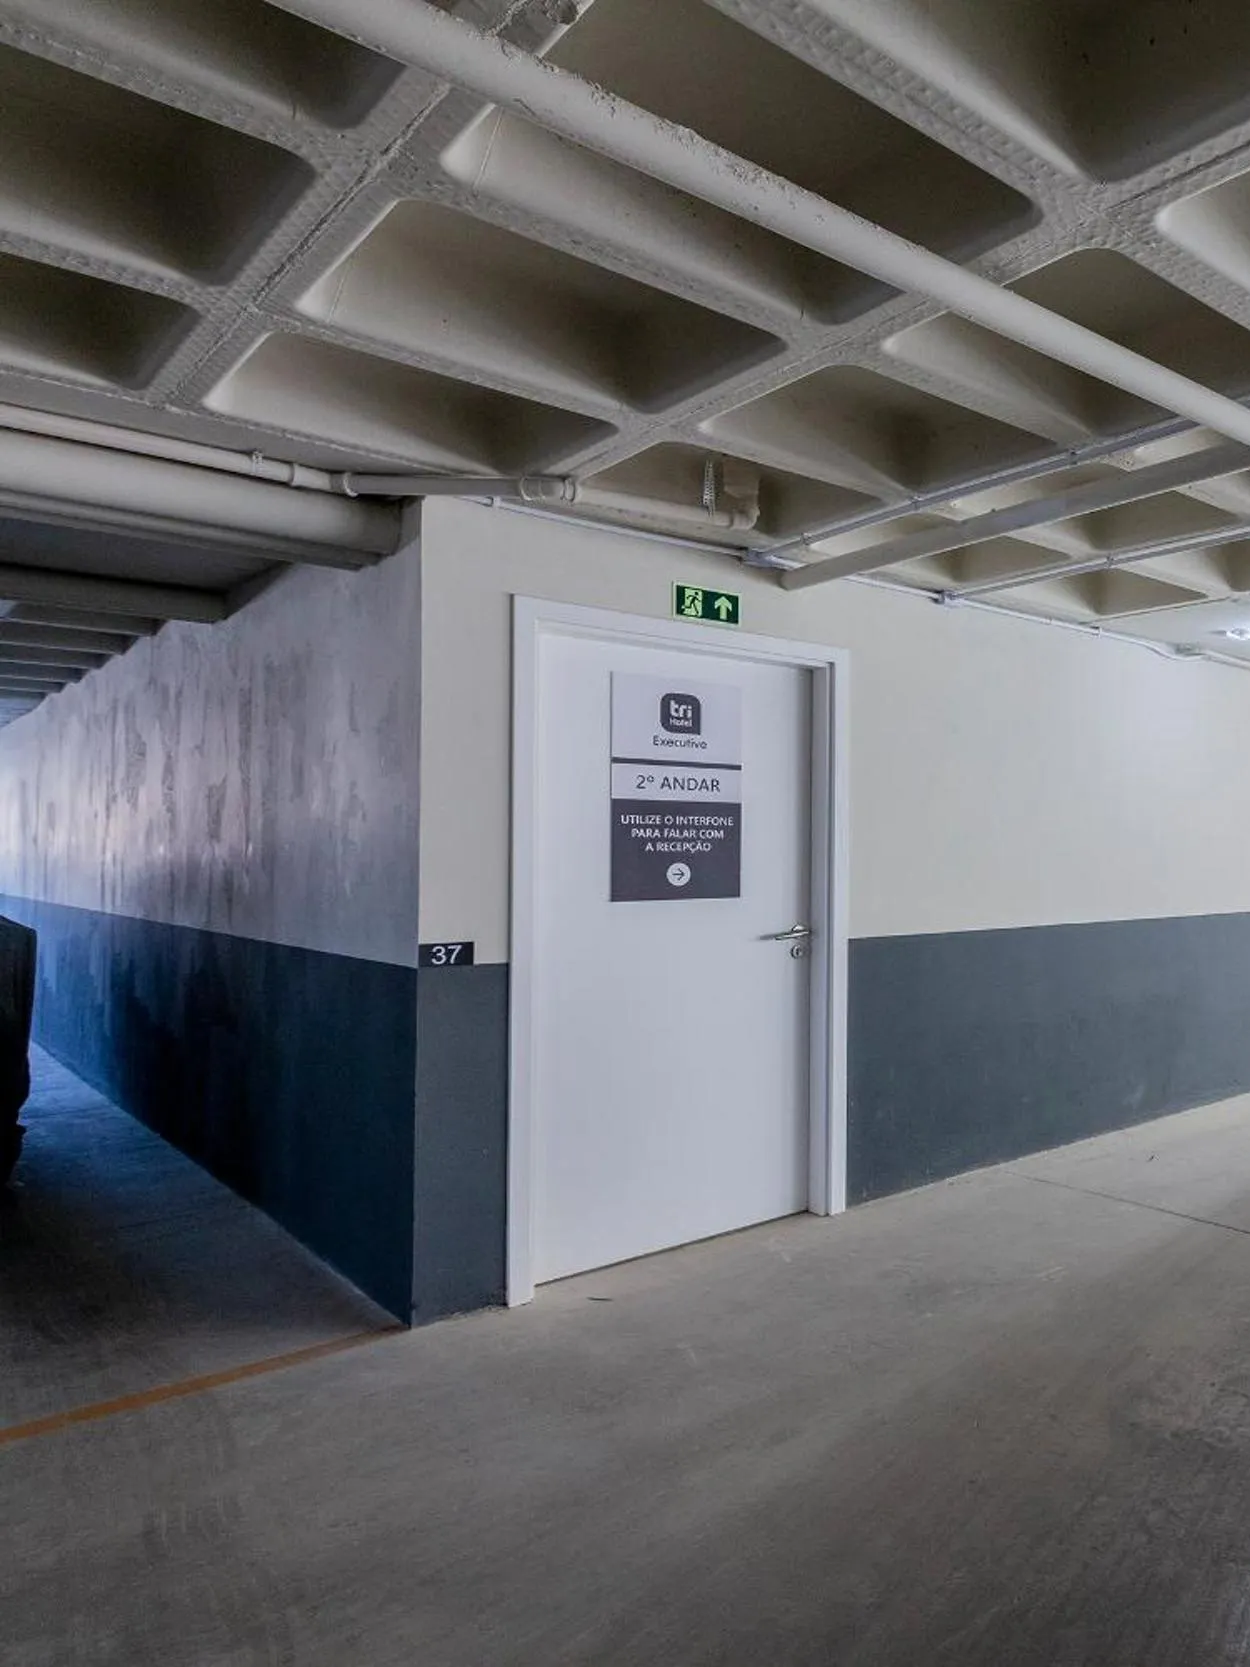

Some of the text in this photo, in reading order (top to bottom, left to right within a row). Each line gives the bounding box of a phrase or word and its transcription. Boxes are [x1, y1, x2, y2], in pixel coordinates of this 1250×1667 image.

[670, 700, 693, 718] tri
[660, 776, 720, 792] ANDAR
[621, 814, 734, 826] UTILIZE O INTERFONE
[631, 828, 724, 840] PARA FALAR COM
[645, 841, 711, 854] A RECEPÇÃO
[431, 945, 462, 965] 37
